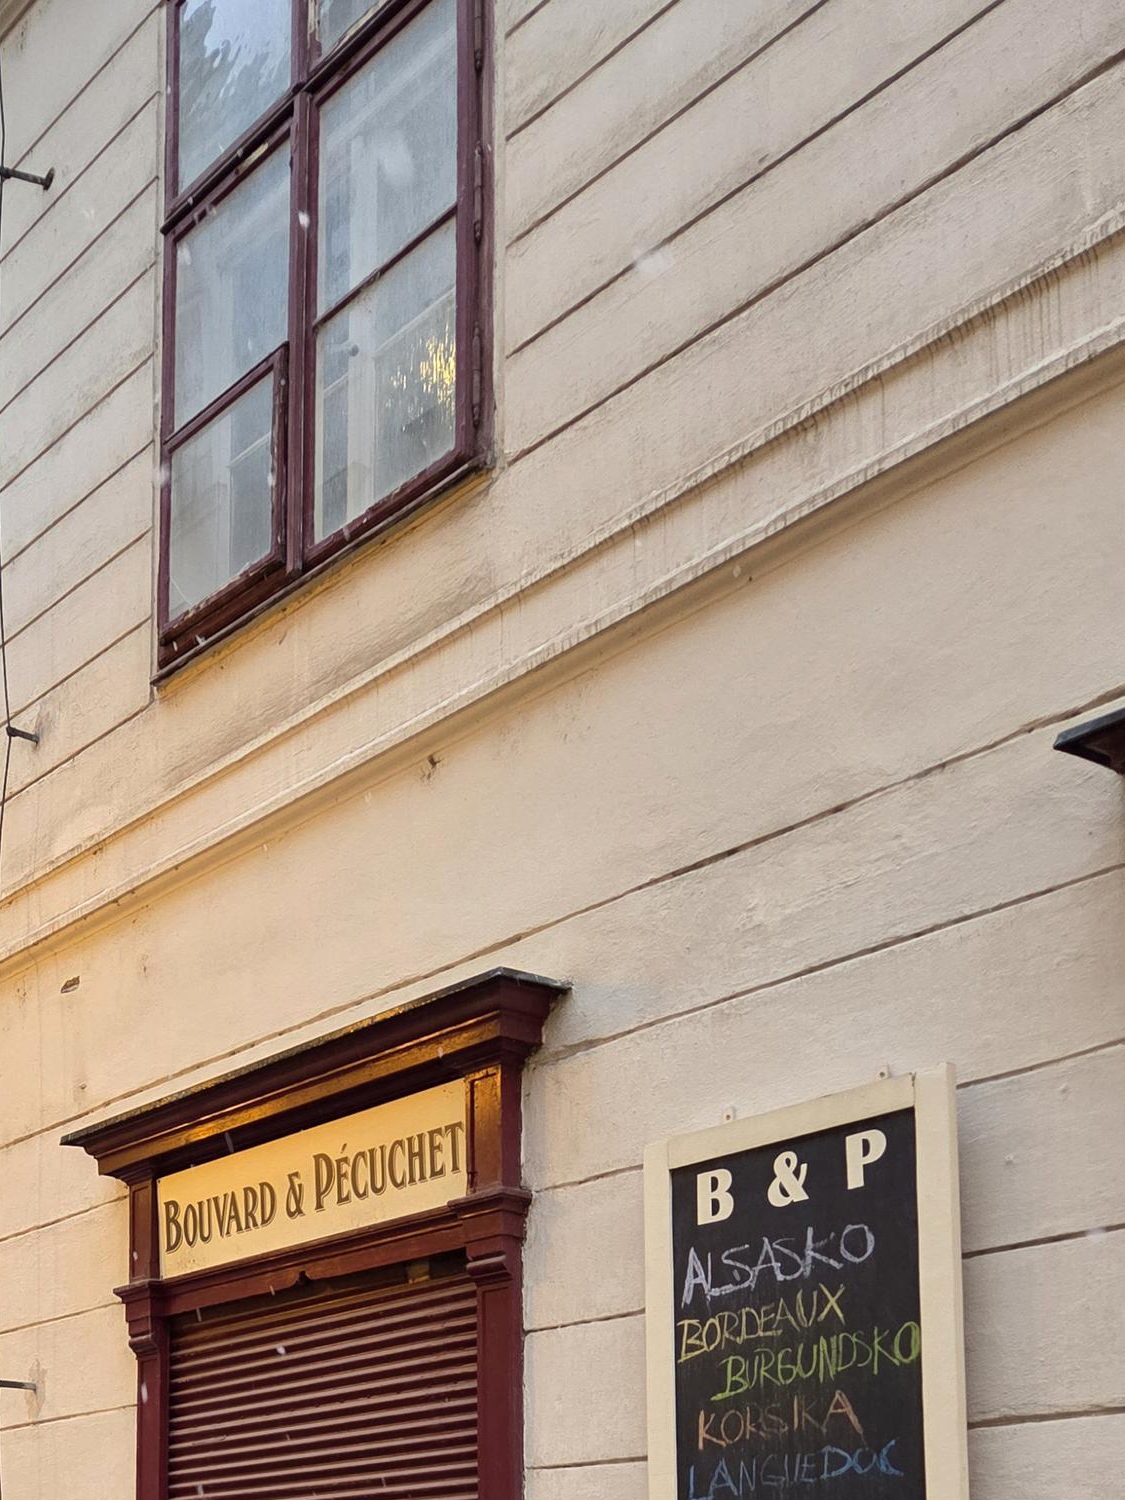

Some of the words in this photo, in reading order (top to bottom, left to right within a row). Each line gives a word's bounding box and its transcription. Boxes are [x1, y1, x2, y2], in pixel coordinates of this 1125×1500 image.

[164, 1181, 276, 1254] BOUVARD
[285, 1171, 306, 1219] &
[697, 1168, 735, 1226] B
[767, 1150, 810, 1208] &
[845, 1128, 887, 1190] P
[681, 1223, 875, 1310] ALSASKO
[676, 1282, 847, 1364] BORDEAUX
[709, 1320, 922, 1401] BURGUNDSKO
[697, 1389, 867, 1451] KORSIKA
